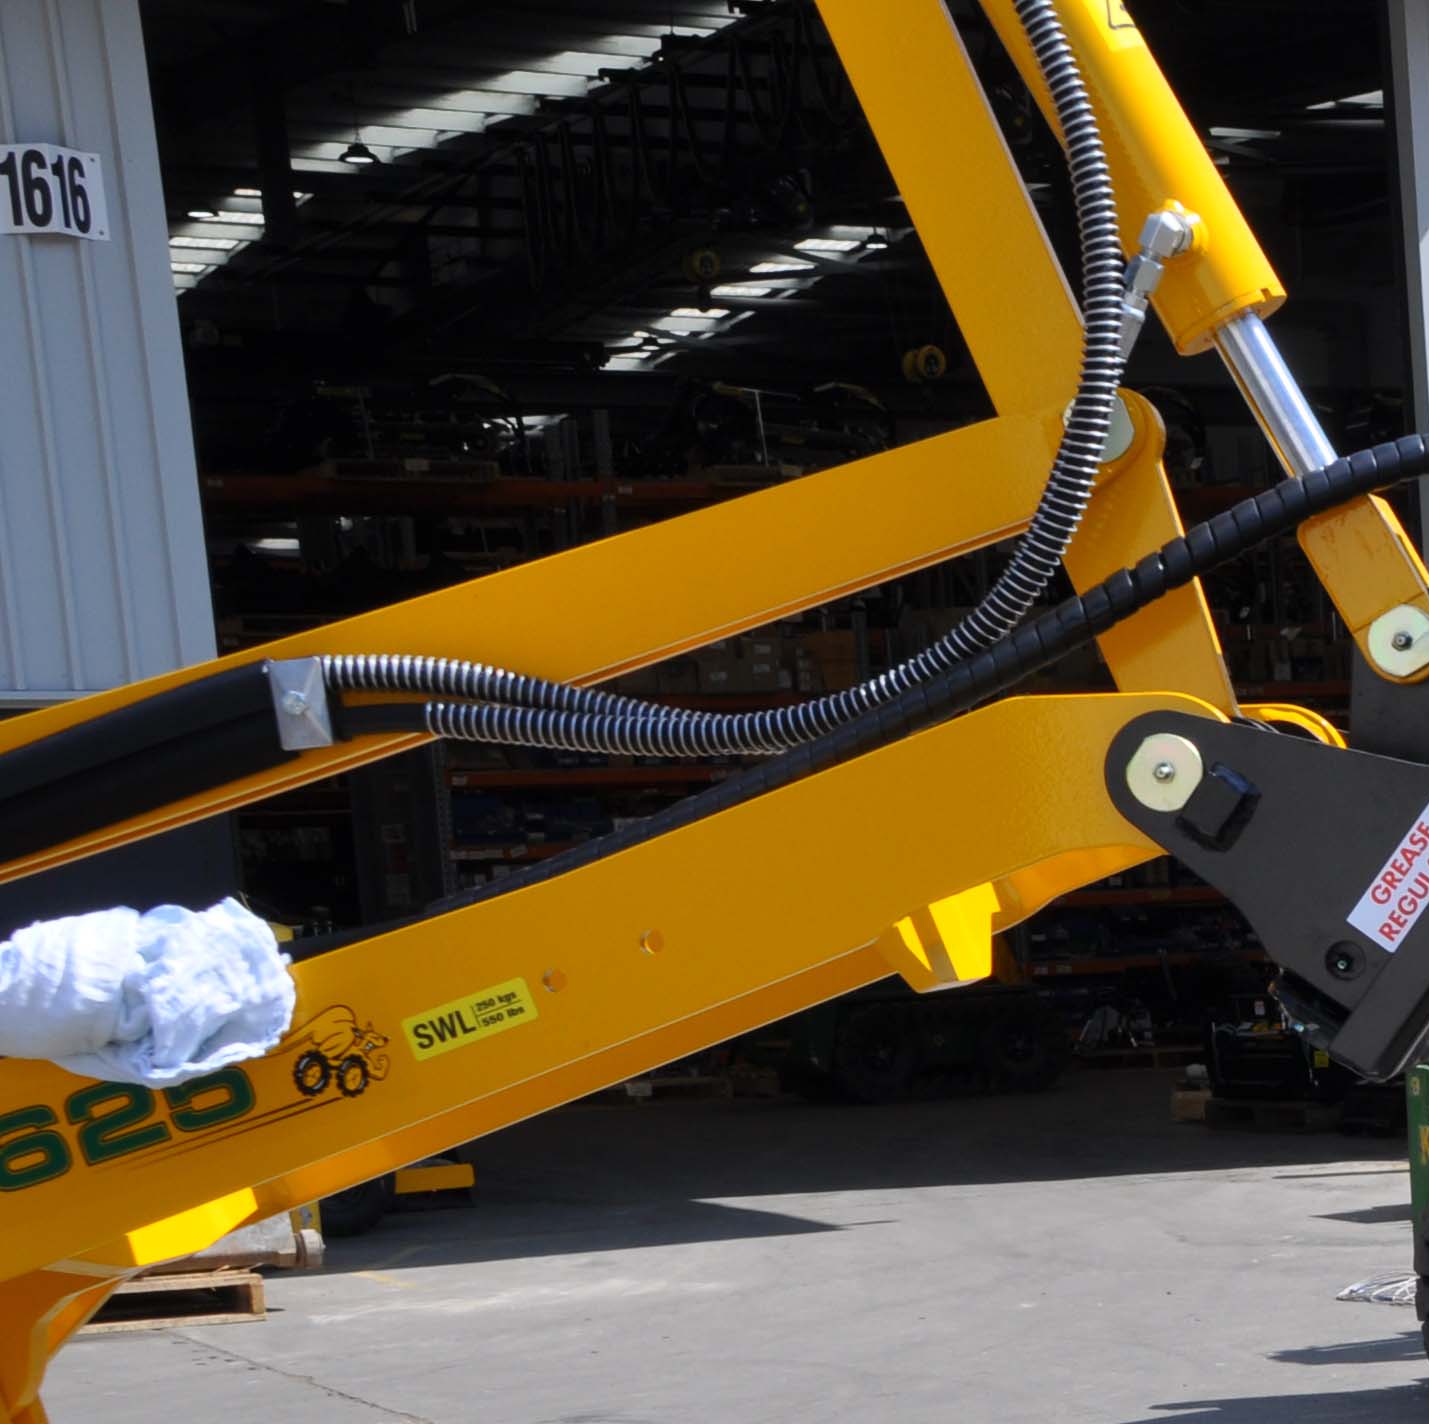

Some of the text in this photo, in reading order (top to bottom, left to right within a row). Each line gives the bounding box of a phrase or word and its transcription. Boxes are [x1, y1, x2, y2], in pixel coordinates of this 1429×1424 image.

[475, 991, 517, 1012] 250 kgs
[481, 1006, 525, 1027] 550 lbs
[413, 1010, 477, 1050] SWL
